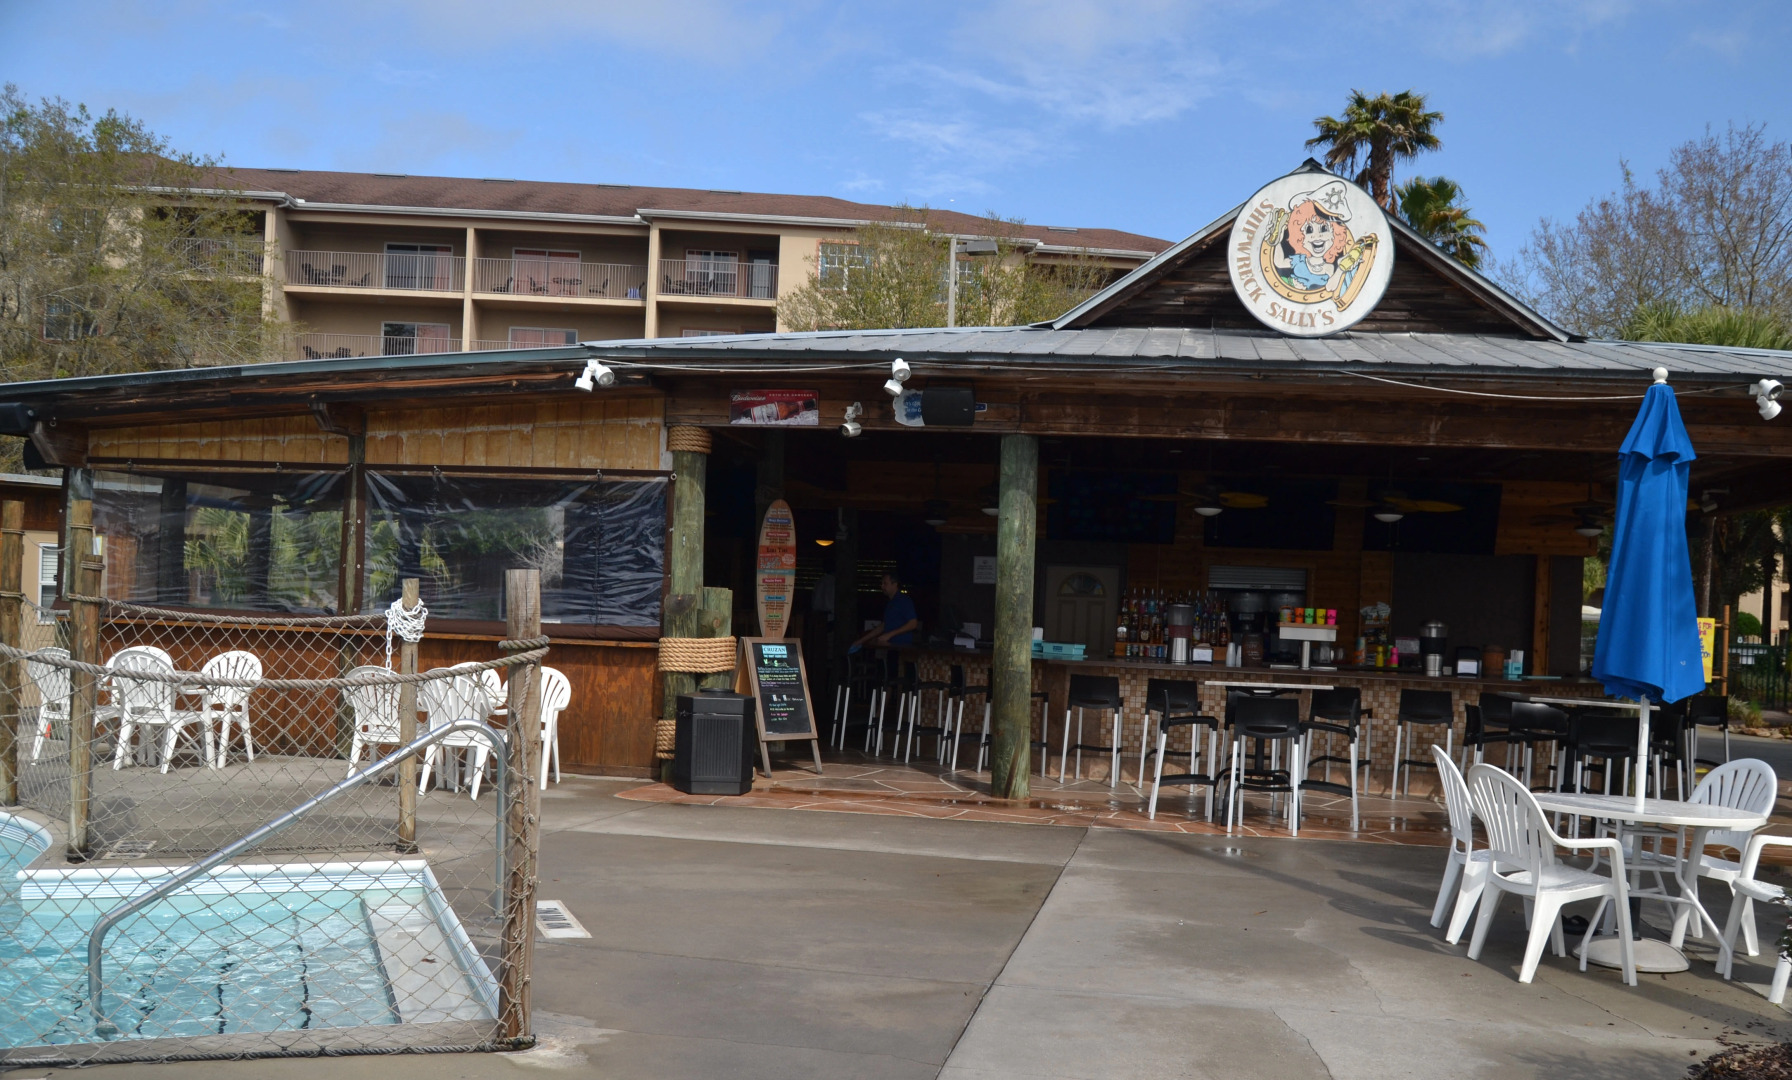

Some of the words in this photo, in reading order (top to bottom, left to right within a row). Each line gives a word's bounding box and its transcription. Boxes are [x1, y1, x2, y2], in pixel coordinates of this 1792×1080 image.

[1237, 198, 1274, 304] SHIPWRECK
[1266, 302, 1334, 328] SALLY'S
[731, 393, 766, 402] Budweiser
